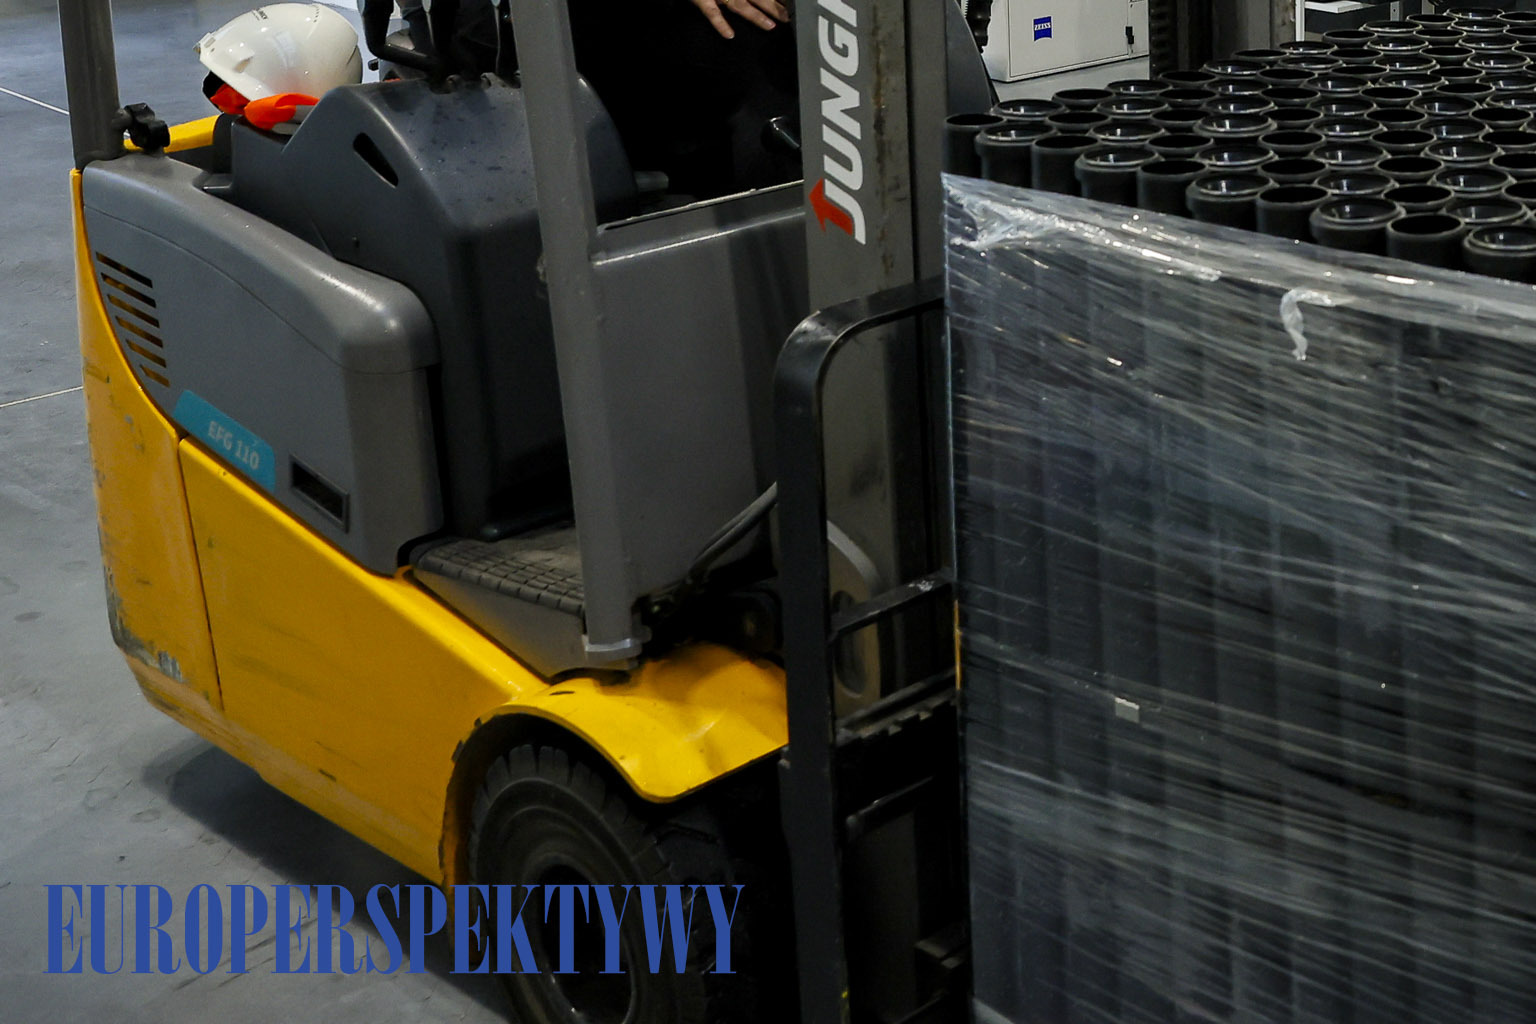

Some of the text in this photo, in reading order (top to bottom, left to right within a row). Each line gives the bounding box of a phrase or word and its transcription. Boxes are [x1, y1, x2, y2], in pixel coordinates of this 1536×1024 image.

[1034, 22, 1051, 31] ZEISS
[207, 420, 259, 470] EFG 110
